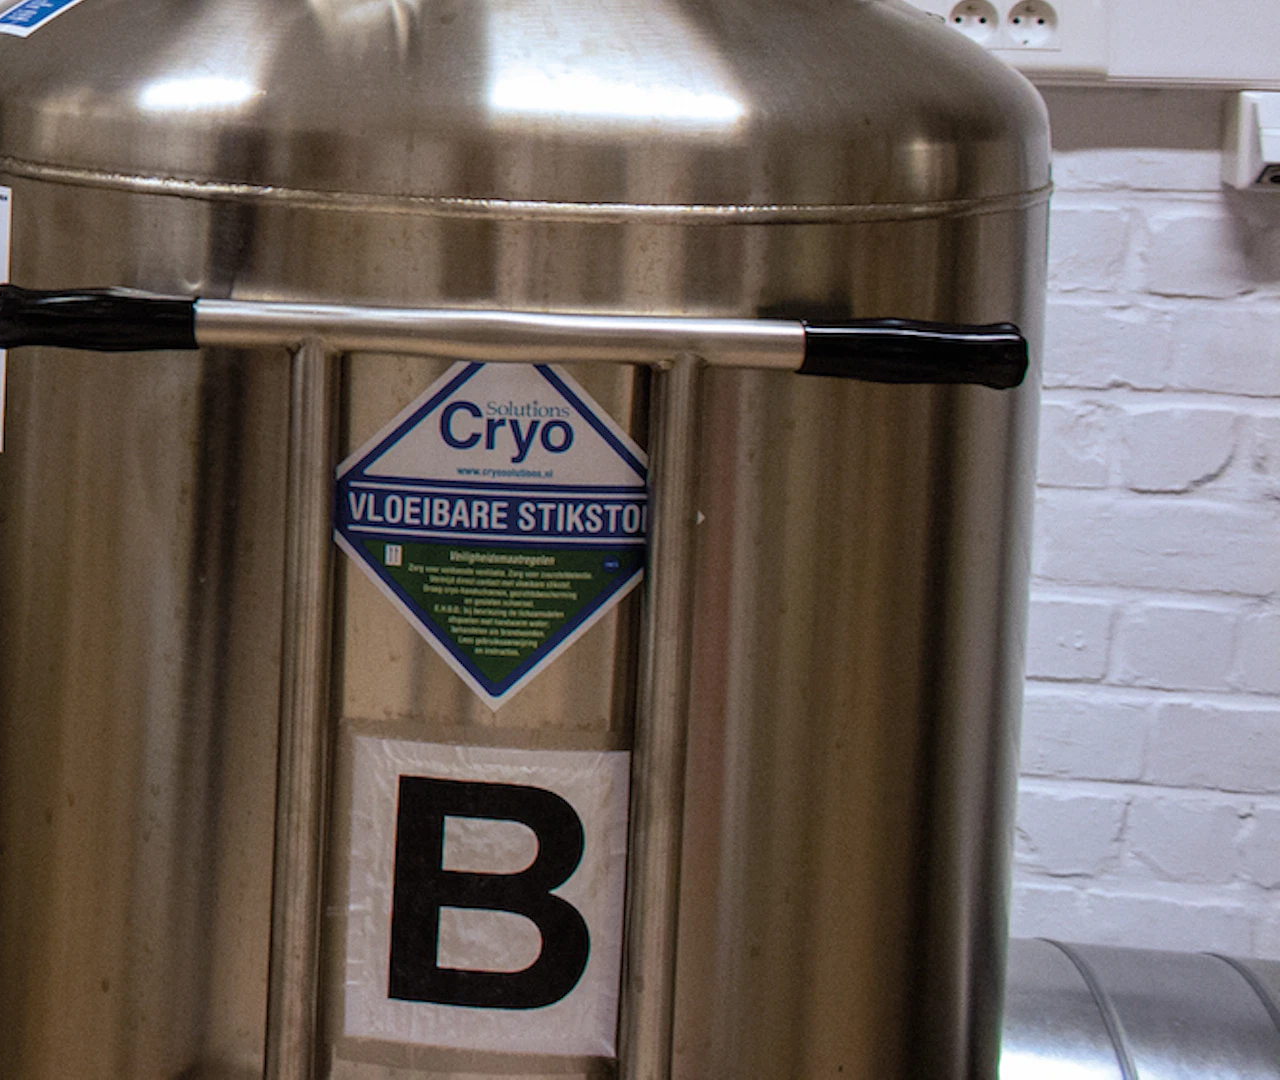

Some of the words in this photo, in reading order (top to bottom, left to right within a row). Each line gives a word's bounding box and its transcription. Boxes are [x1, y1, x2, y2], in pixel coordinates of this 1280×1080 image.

[440, 401, 574, 463] Cryo
[486, 400, 571, 417] Solutions
[348, 491, 509, 530] VLOEIBARE
[387, 775, 591, 1011] B
